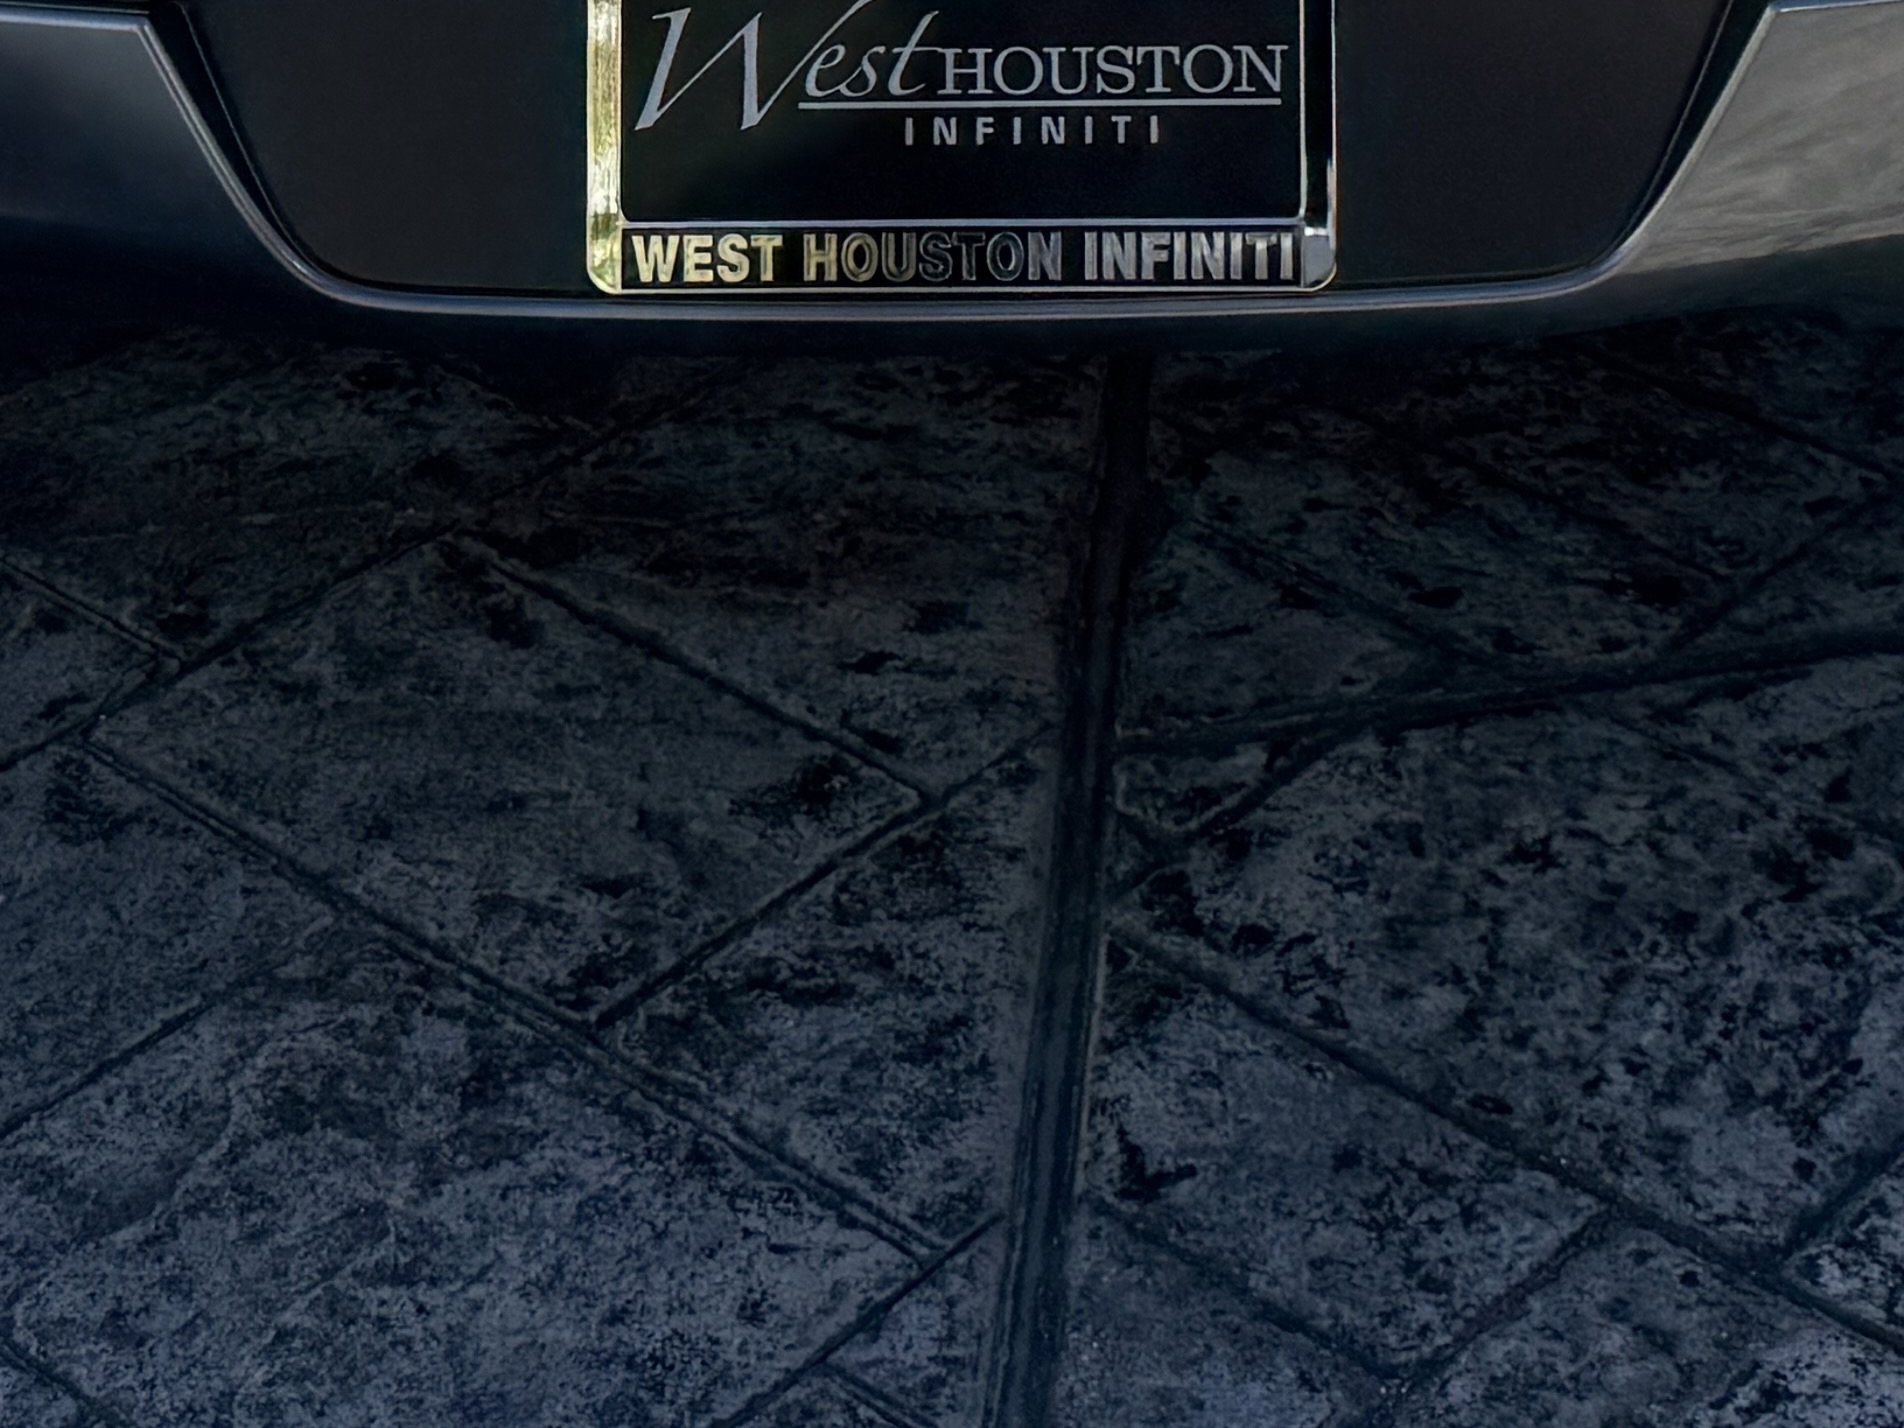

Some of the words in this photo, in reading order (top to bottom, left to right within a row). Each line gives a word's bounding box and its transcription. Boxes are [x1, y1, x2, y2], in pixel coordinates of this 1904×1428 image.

[938, 44, 1290, 96] HOUSTON
[904, 115, 1161, 145] INFINITI
[632, 232, 785, 285] WEST
[803, 231, 1063, 283] HOUSTON
[1083, 231, 1296, 282] INFINITI
